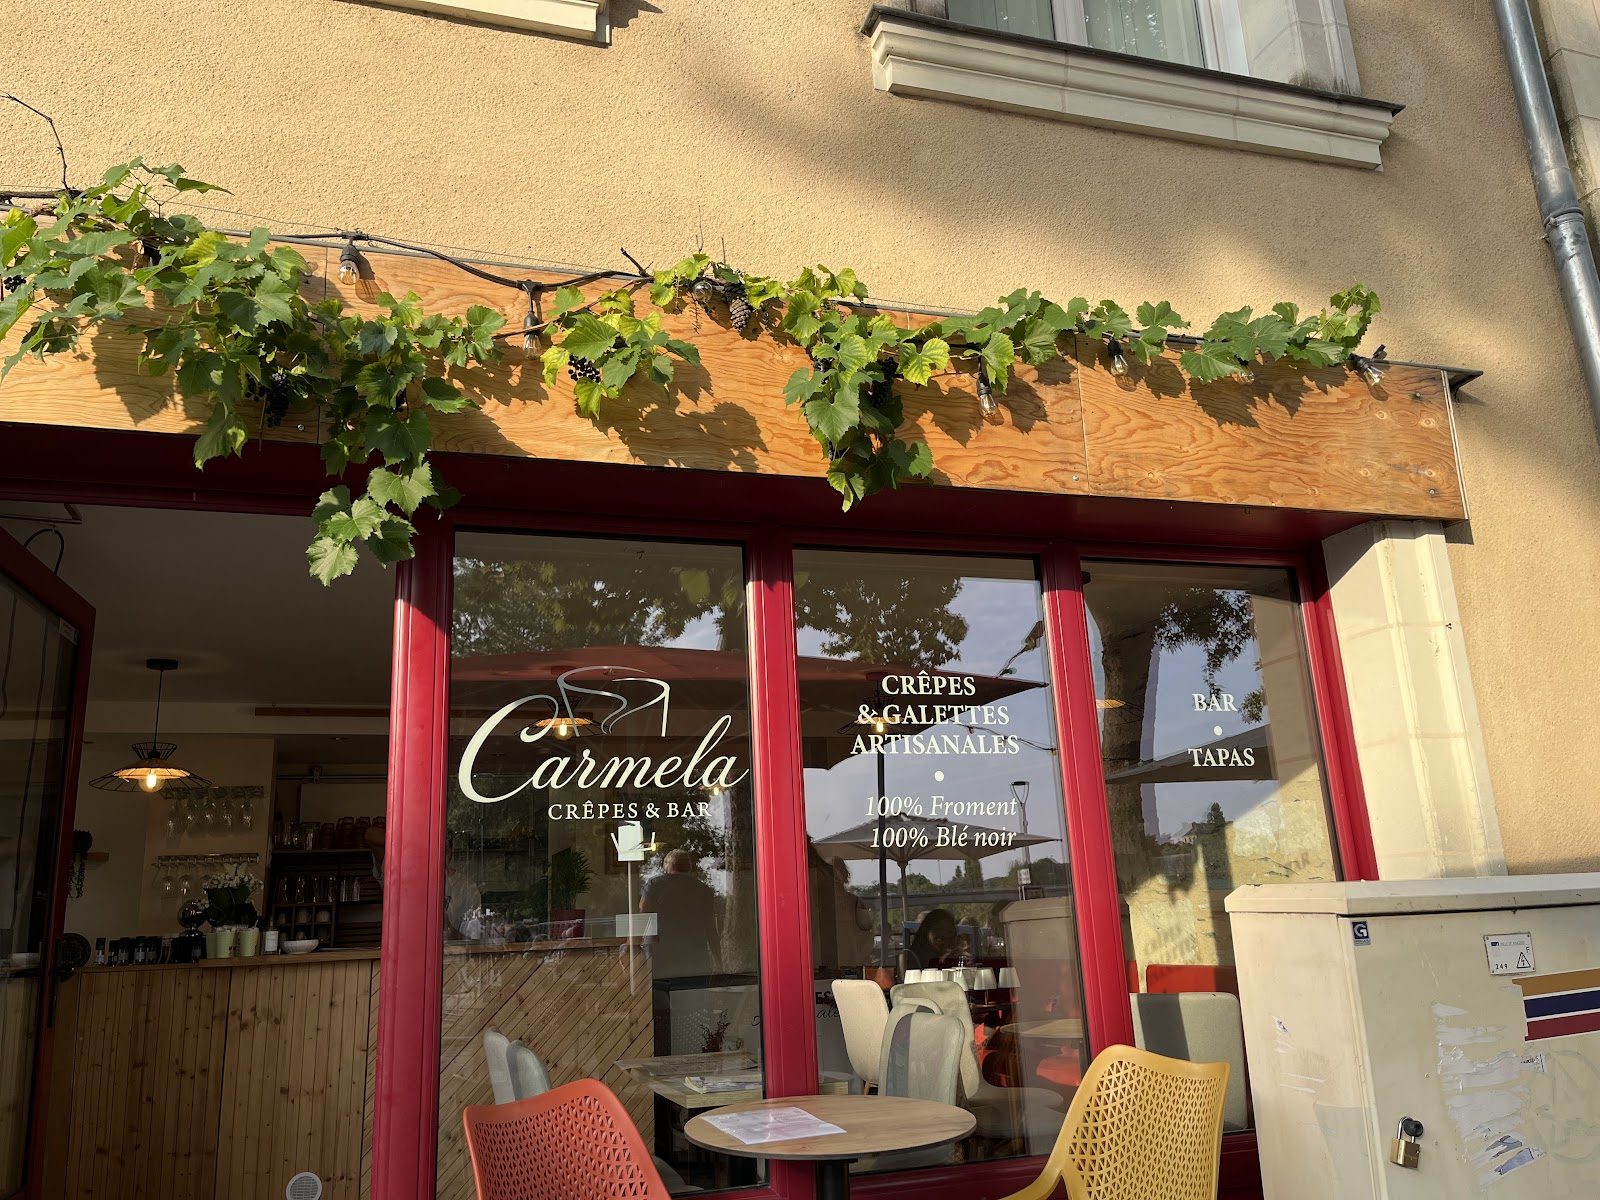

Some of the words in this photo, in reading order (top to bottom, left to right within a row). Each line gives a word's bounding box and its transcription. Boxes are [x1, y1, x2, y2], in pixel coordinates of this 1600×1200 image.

[882, 670, 976, 696] CRÊPES
[1192, 693, 1238, 712] BAR
[857, 704, 879, 725] &
[882, 704, 1010, 725] GALETTES
[458, 694, 749, 803] Carmela
[850, 734, 1020, 755] ARTISANALES
[1188, 747, 1255, 767] TAPAS
[548, 800, 638, 820] CRÊPES
[645, 803, 661, 819] &
[667, 802, 712, 818] BAR
[865, 796, 923, 816] 100%
[930, 795, 1018, 816] Froment
[870, 827, 929, 848] 100%
[935, 825, 968, 847] Blé
[974, 827, 1017, 847] noir
